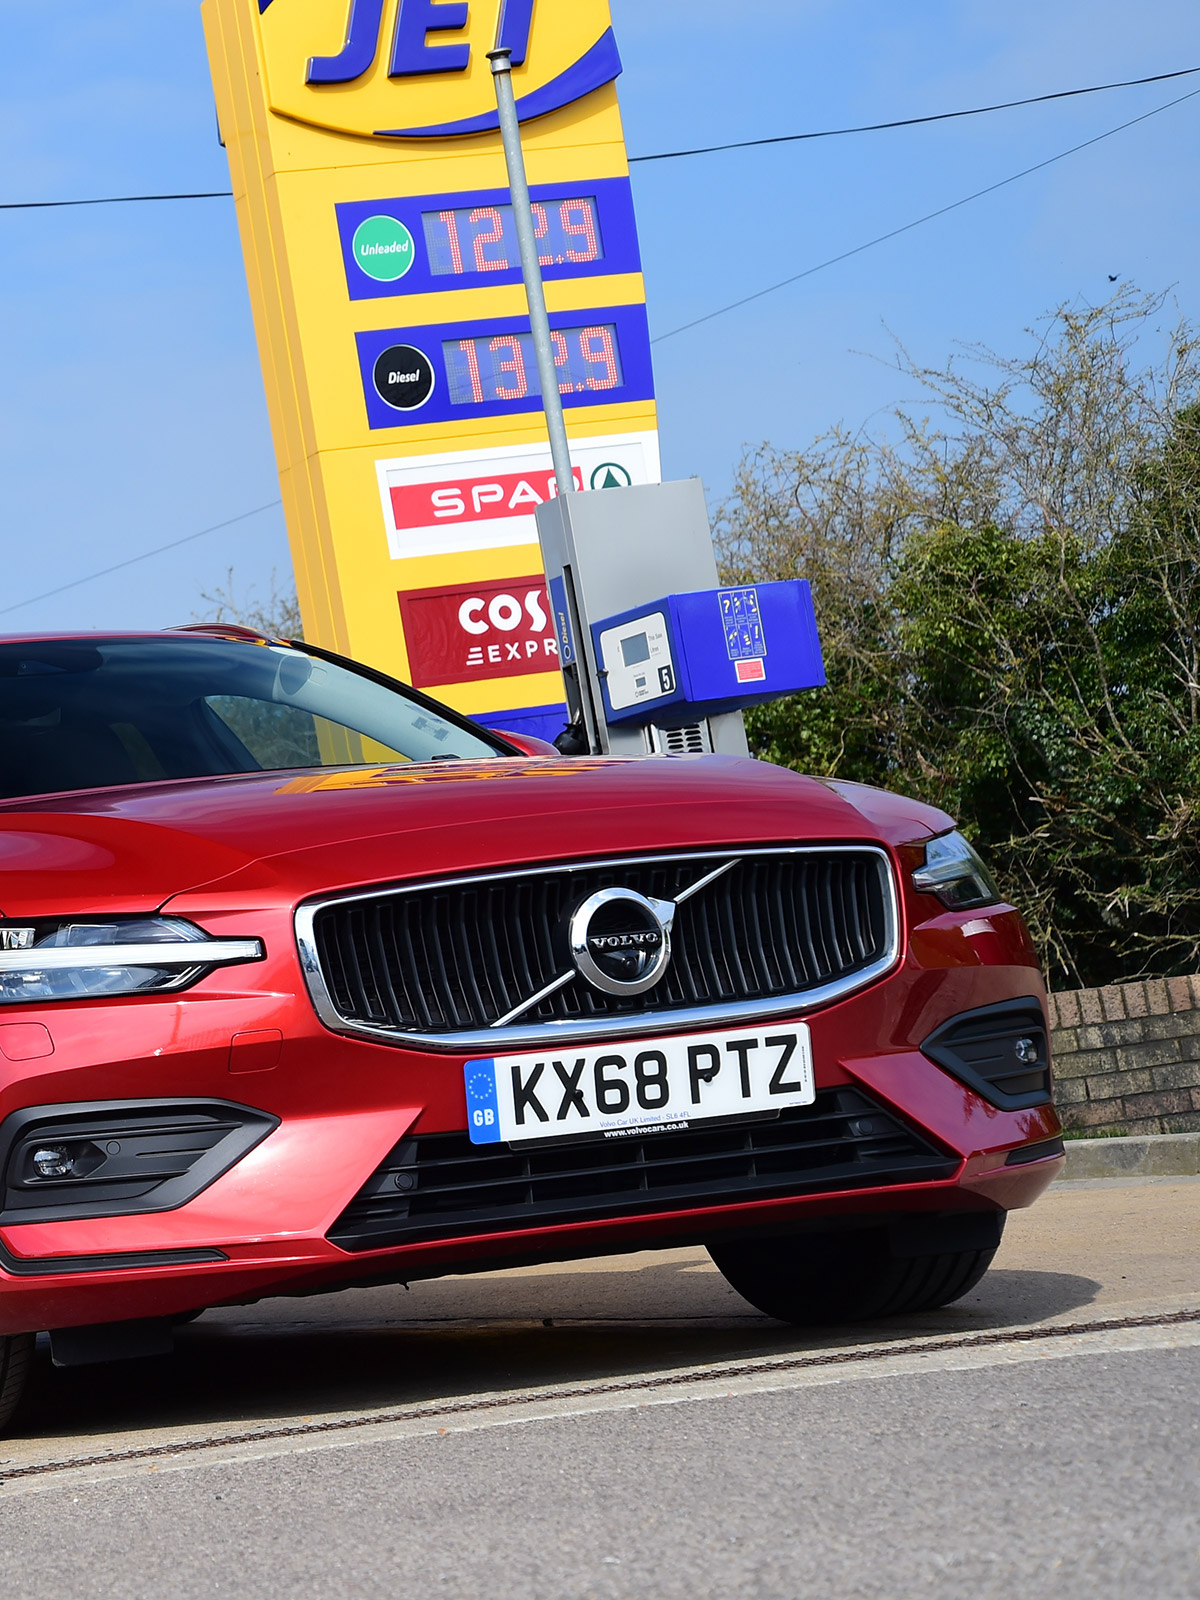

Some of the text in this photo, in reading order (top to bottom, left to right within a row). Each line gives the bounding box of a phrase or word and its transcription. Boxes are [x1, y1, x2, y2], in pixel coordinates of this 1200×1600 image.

[360, 239, 409, 256] Unleaded
[388, 369, 420, 385] Diesel
[458, 590, 550, 635] COS
[558, 611, 569, 644] Diesel
[661, 668, 671, 690] 5
[590, 932, 659, 949] VOLVO
[511, 1050, 670, 1126] KX68
[687, 1034, 801, 1105] PTZ
[473, 1108, 495, 1127] GB
[617, 1118, 628, 1126] Car
[629, 1117, 640, 1125] UK
[640, 1115, 661, 1123] Limited
[604, 1121, 689, 1138] www.volvocars.co.uk
